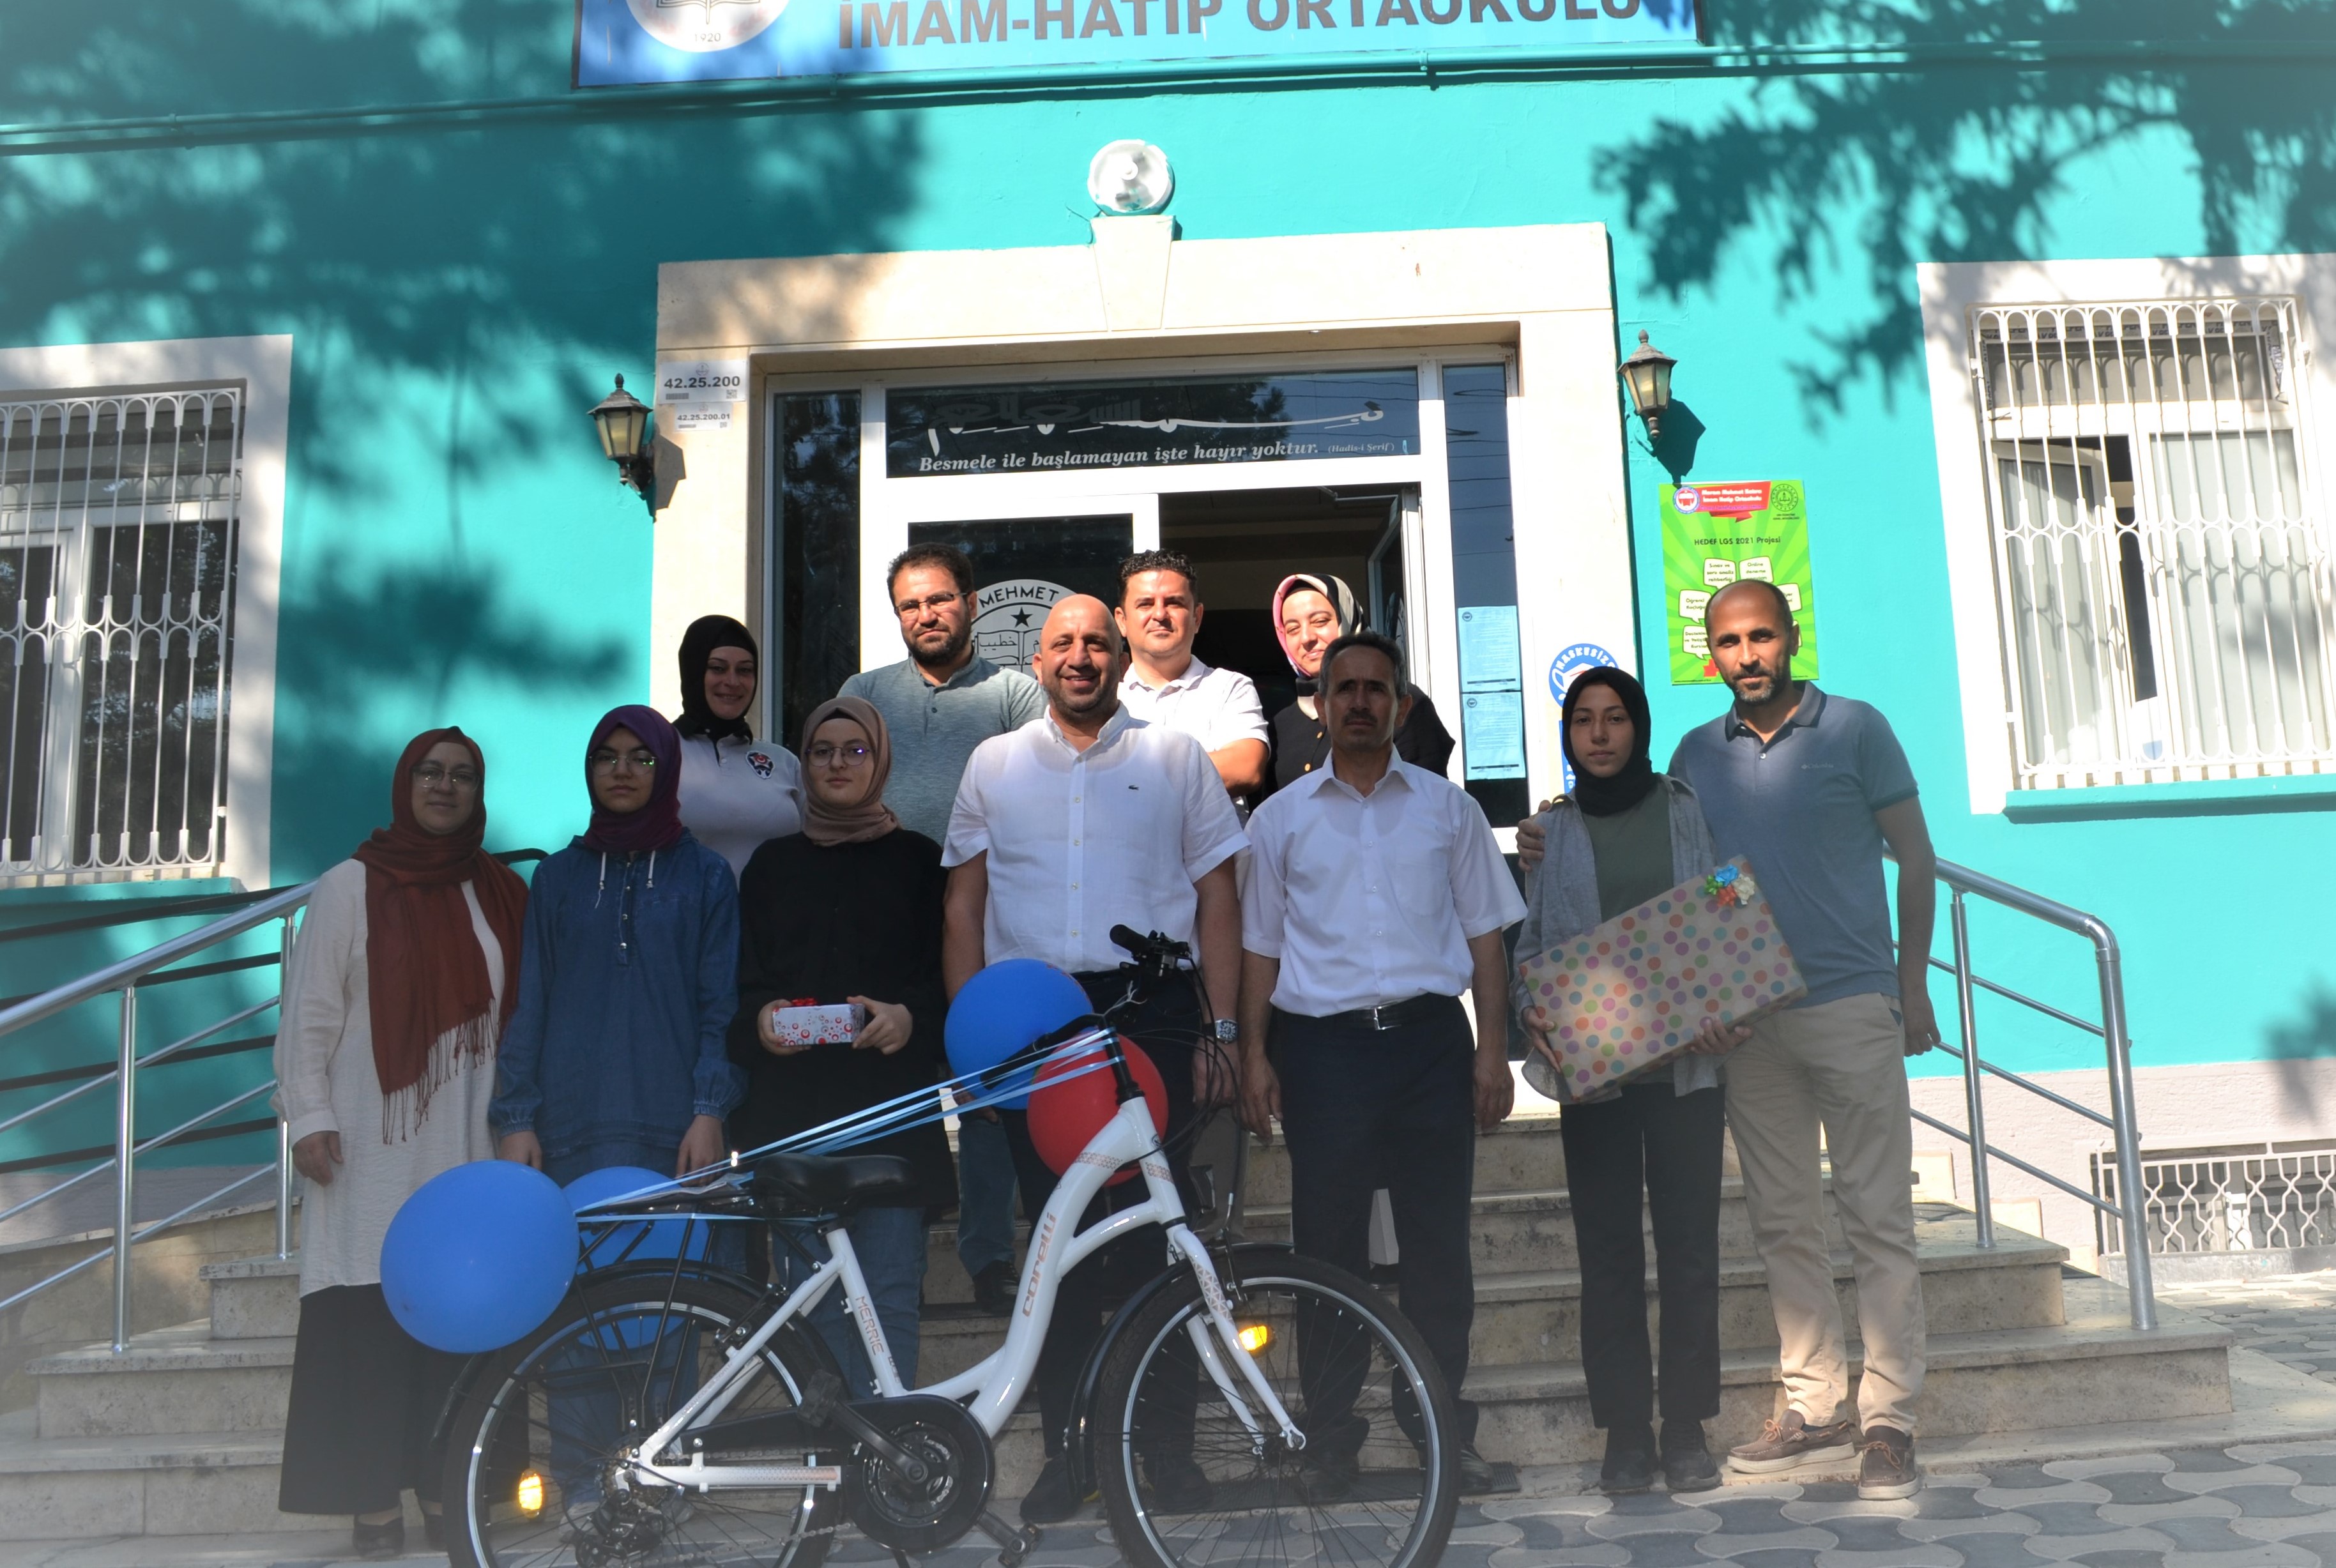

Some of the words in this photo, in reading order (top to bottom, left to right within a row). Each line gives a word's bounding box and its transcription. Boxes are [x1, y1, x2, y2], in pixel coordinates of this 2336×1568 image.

[694, 33, 721, 42] 1920
[664, 376, 741, 389] 42.25.200
[919, 452, 996, 471] Besmele
[1002, 453, 1025, 468] ile
[1031, 450, 1149, 469] başlamayan
[1154, 446, 1187, 464] işte
[1252, 440, 1318, 460] yoktur.
[1327, 443, 1365, 454] (Hadis-i
[1756, 537, 1781, 545] Projesi
[978, 586, 1060, 608] MEHMET
[1022, 1212, 1057, 1318] corelli
[855, 1295, 885, 1356] MERRIE
